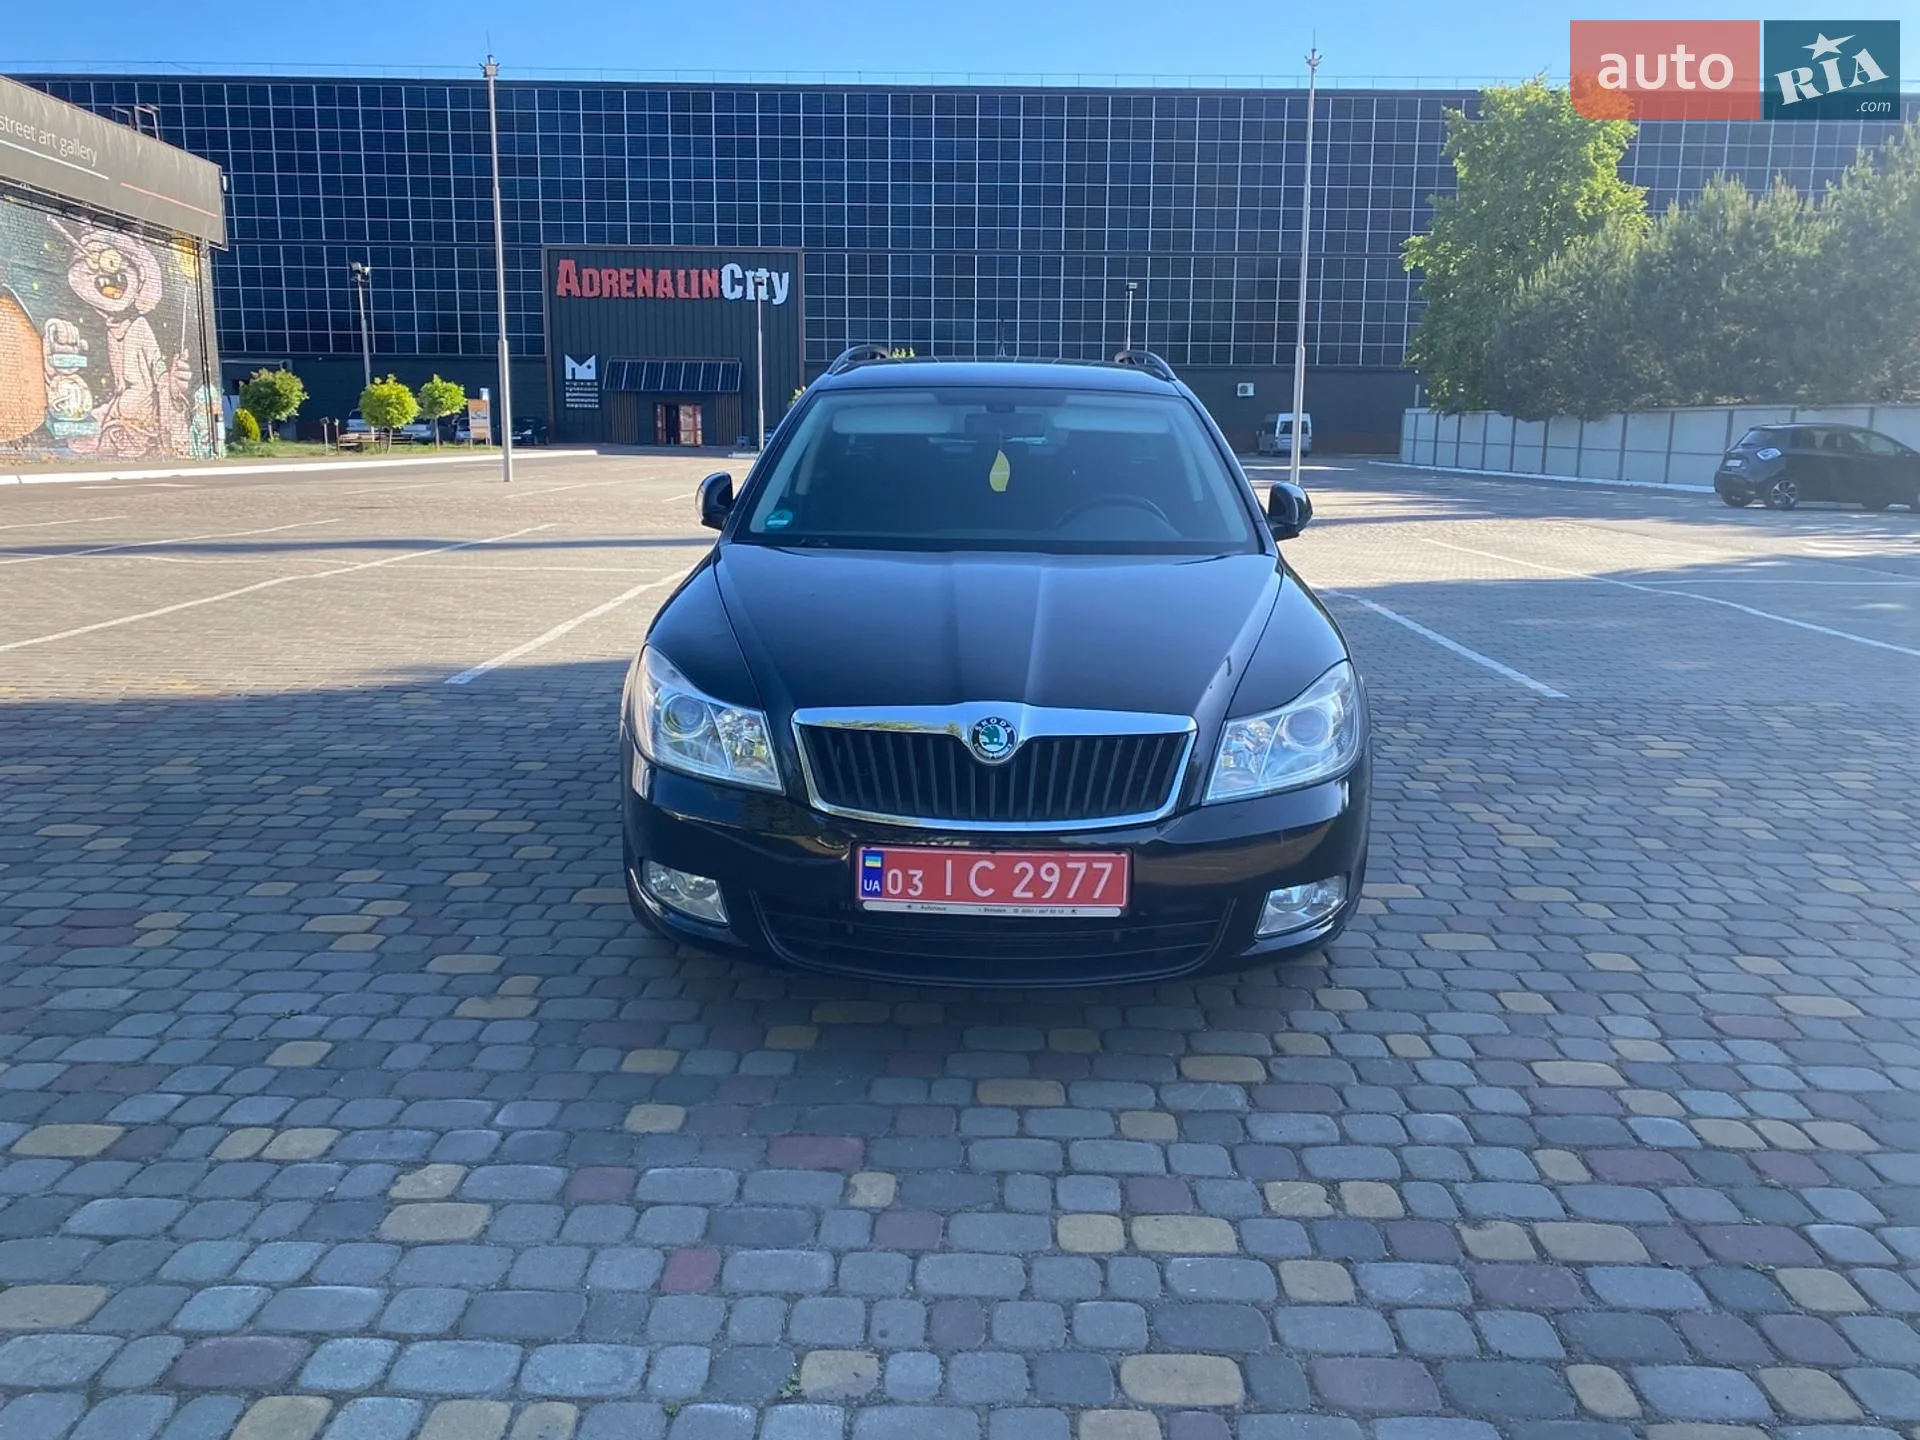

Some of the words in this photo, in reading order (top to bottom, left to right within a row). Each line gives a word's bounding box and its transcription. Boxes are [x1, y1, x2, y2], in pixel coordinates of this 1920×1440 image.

[0, 114, 36, 142] street
[38, 130, 57, 149] art
[60, 136, 98, 167] gallery
[863, 879, 881, 892] UA
[887, 868, 924, 896] 03
[1012, 861, 1113, 899] 2977
